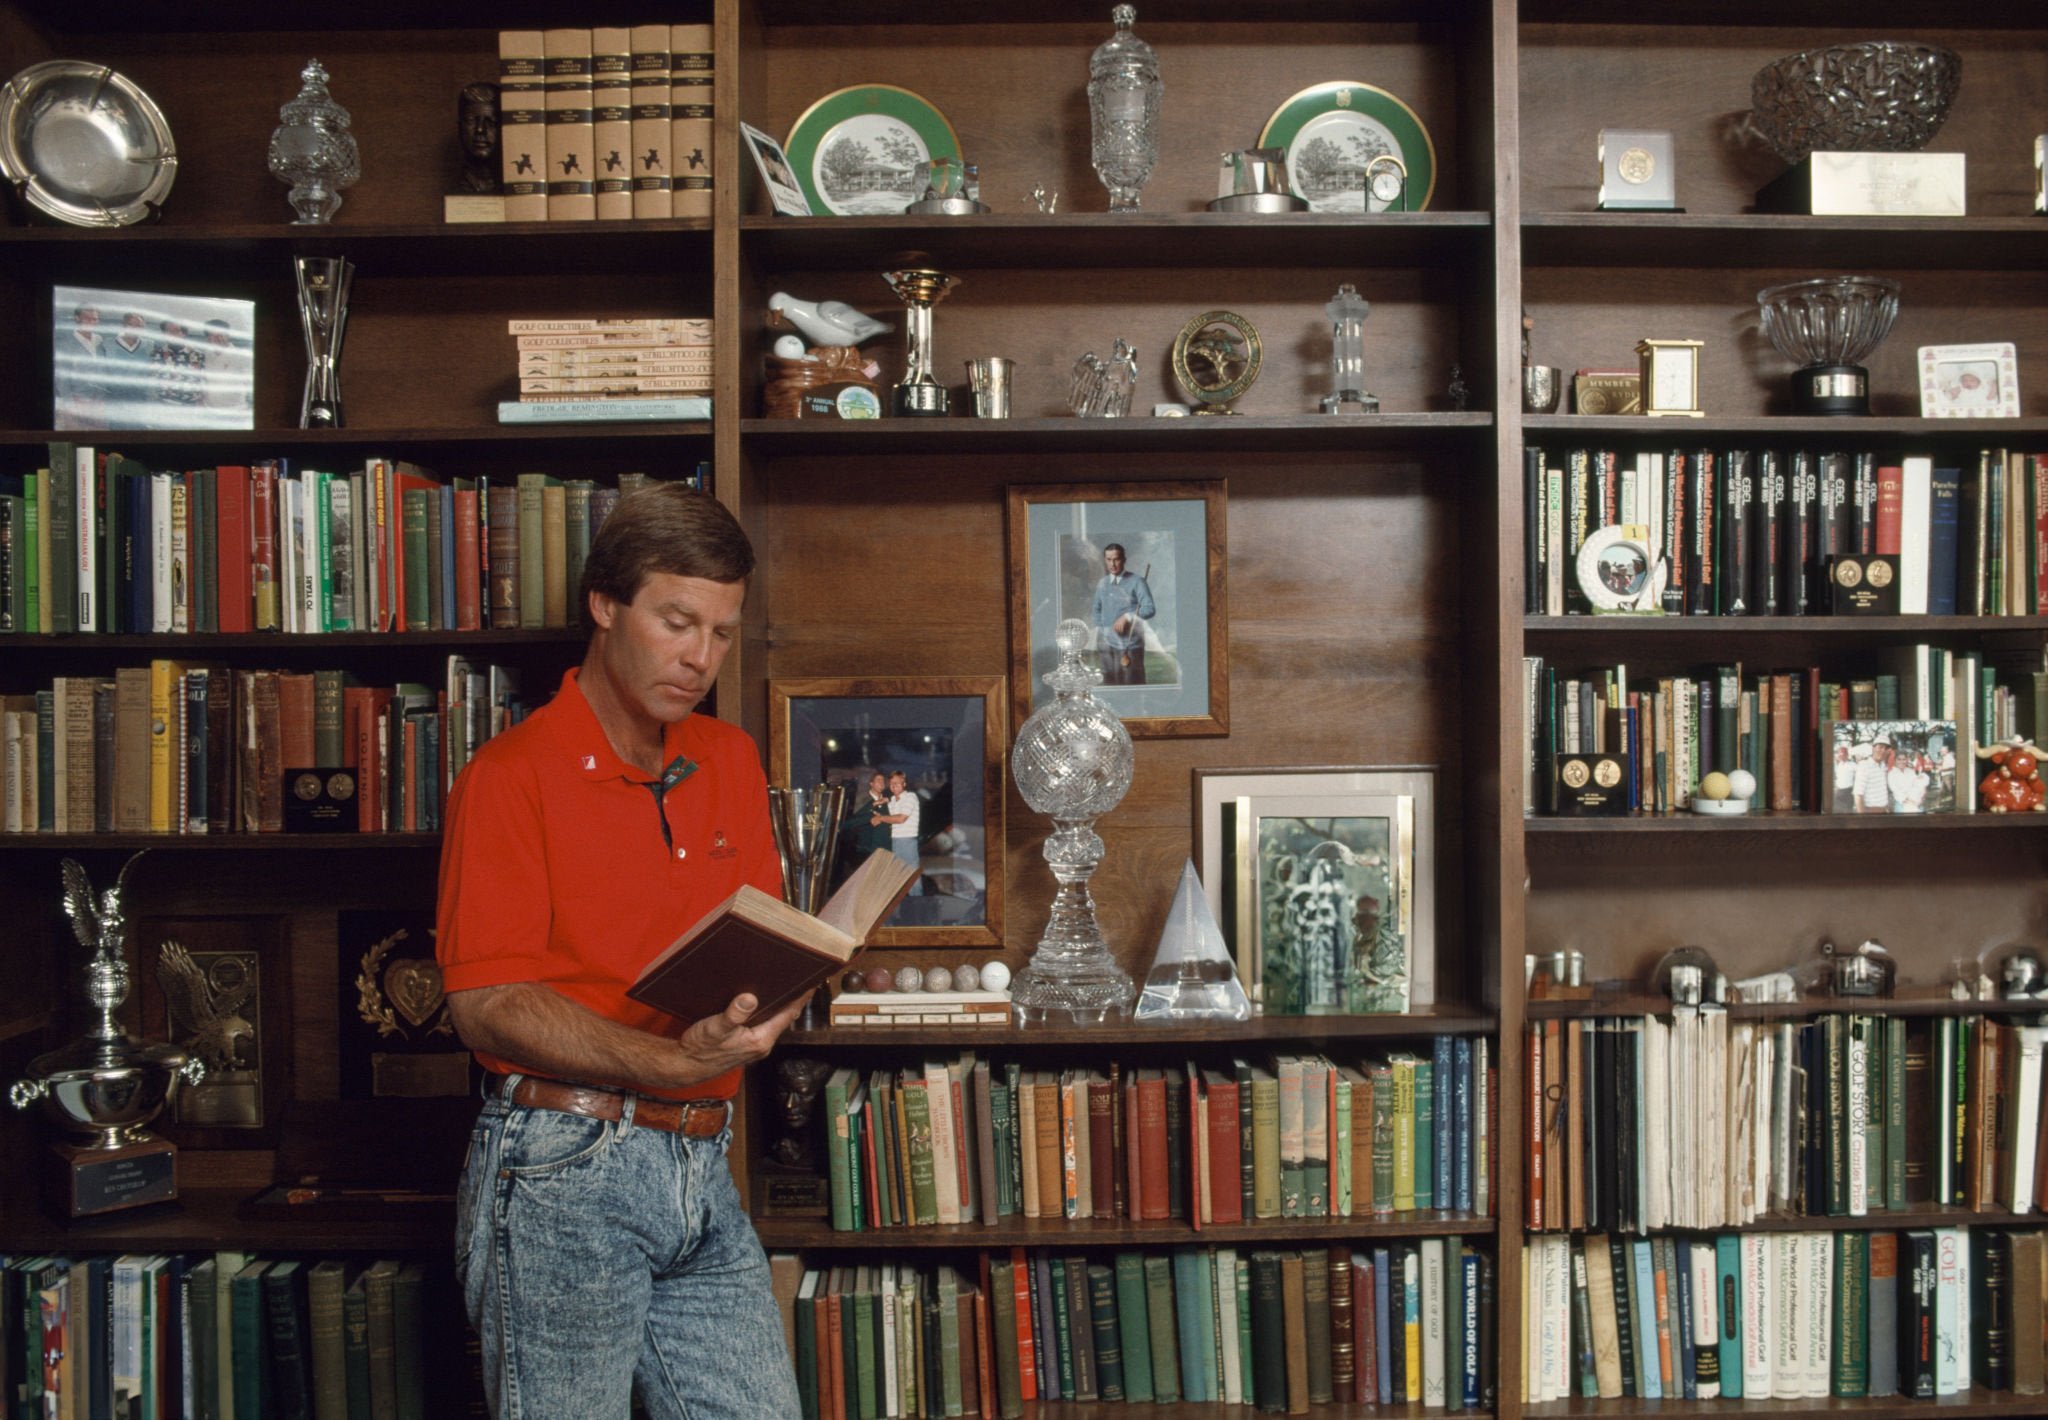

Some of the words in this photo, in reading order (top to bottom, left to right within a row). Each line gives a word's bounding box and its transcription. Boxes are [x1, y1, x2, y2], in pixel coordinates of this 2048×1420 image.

[813, 398, 834, 406] ANNUAL
[1676, 456, 1685, 471] The
[1705, 455, 1713, 472] The
[1578, 472, 1587, 497] World
[1606, 472, 1615, 496] World
[1675, 473, 1684, 497] World
[1704, 473, 1712, 497] World
[1742, 477, 1751, 506] EBEL
[1775, 475, 1784, 504] EBEL
[1807, 474, 1815, 503] EBEL
[1835, 479, 1844, 507] EBEL
[1937, 490, 1953, 498] Falls
[377, 499, 383, 508] OF
[1675, 500, 1683, 509] of
[1704, 500, 1712, 509] of
[1863, 486, 1871, 522] Professional
[1550, 511, 1560, 536] GOLF
[1633, 528, 1637, 538] 1
[1674, 510, 1683, 565] Professional
[1703, 509, 1712, 565] Professional
[1673, 566, 1681, 585] Golf
[1702, 566, 1711, 584] Golf
[1831, 1051, 1841, 1079] GOLF
[1852, 1050, 1864, 1088] GOLF
[1831, 1082, 1841, 1117] STORY
[1832, 1120, 1841, 1129] by
[1852, 1090, 1864, 1137] STORY
[1986, 1095, 1994, 1151] BECOMING
[1852, 1140, 1861, 1181] Charles
[1852, 1184, 1862, 1210] Price
[1545, 1246, 1554, 1265] Jack
[1757, 1239, 1765, 1255] The
[1941, 1236, 1955, 1285] GOLF
[1466, 1263, 1476, 1287] THE
[1758, 1281, 1765, 1290] of
[1790, 1280, 1797, 1290] of
[1820, 1280, 1827, 1290] of
[1913, 1268, 1921, 1279] Golf
[1073, 1280, 1082, 1311] TAYLOR
[1545, 1267, 1554, 1308] Nicklaus
[884, 1294, 895, 1326] GOLF
[1431, 1304, 1437, 1315] OF
[1466, 1288, 1476, 1328] WORLD
[1758, 1291, 1766, 1344] Professional
[1789, 1290, 1797, 1342] Professional
[1467, 1329, 1476, 1344] OF
[1544, 1321, 1554, 1341] Golf
[1467, 1345, 1477, 1375] GOLF
[1543, 1344, 1553, 1357] My
[1758, 1344, 1766, 1363] Golf
[1789, 1343, 1797, 1361] Golf
[1543, 1358, 1553, 1376] Way
